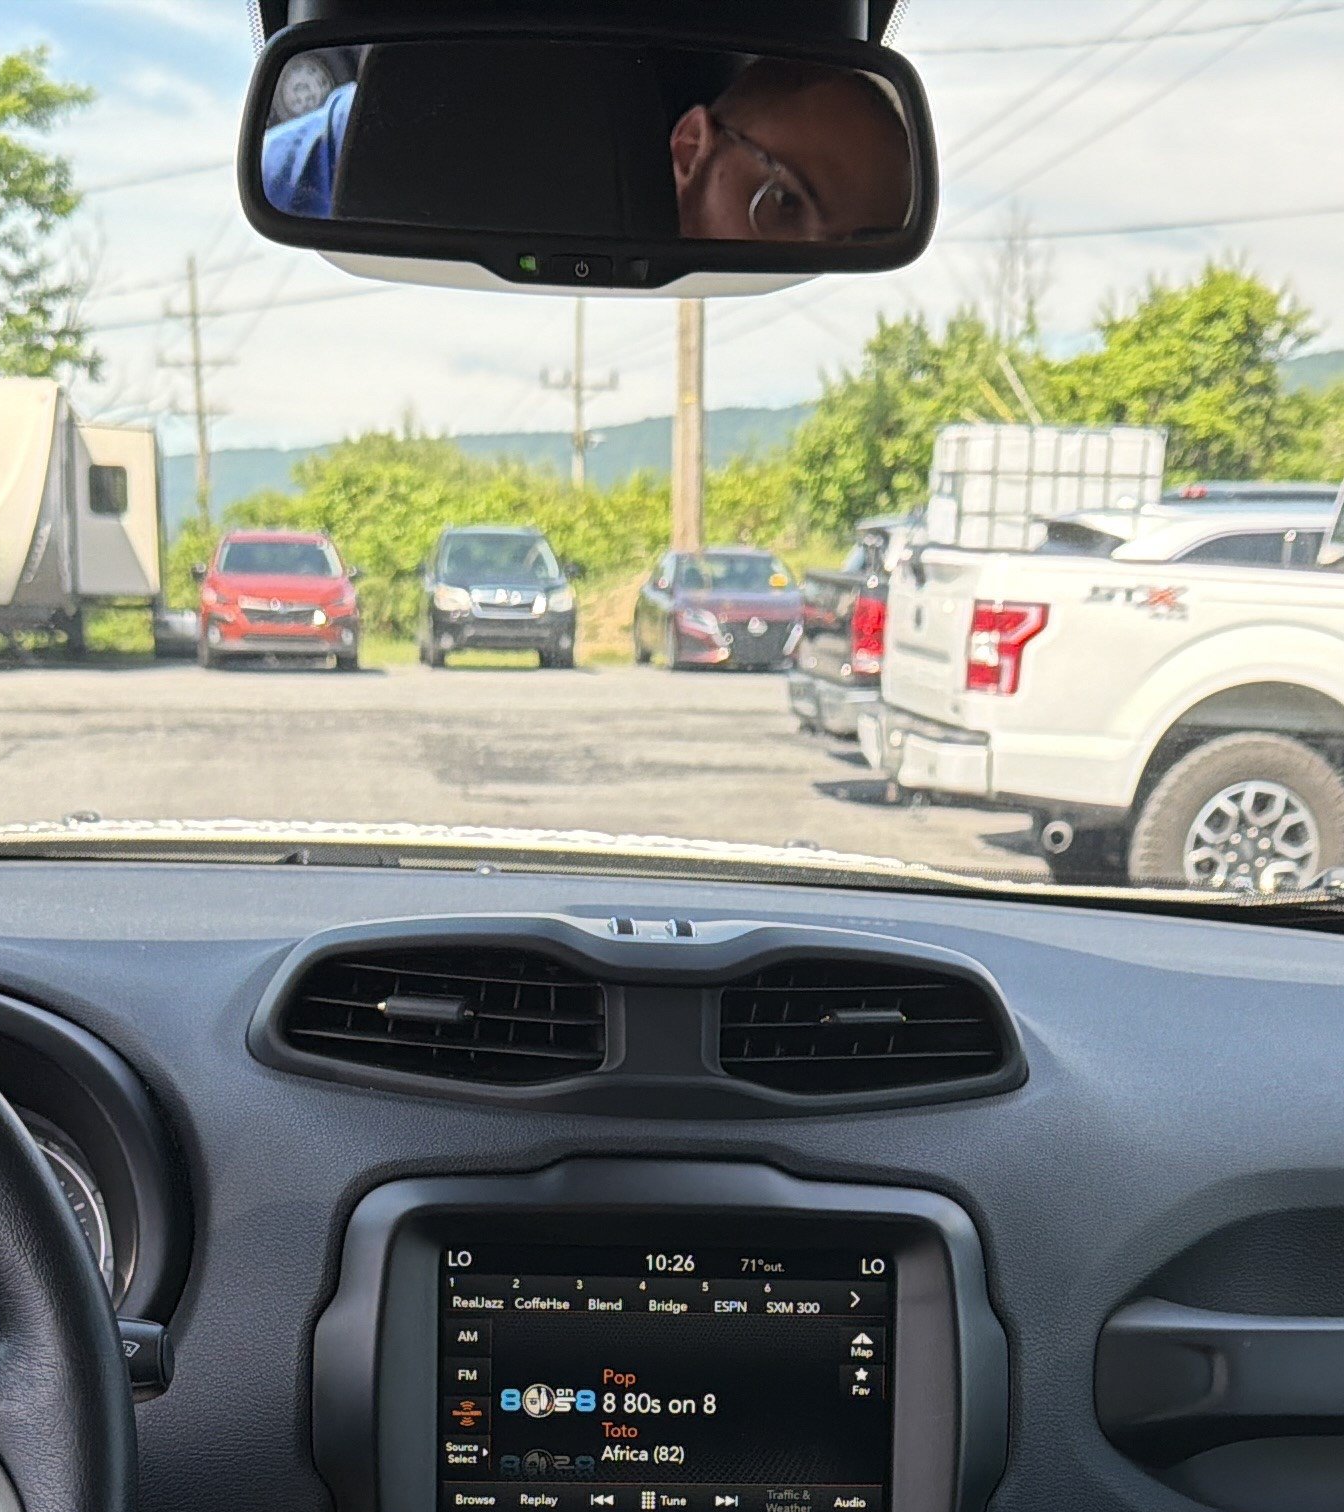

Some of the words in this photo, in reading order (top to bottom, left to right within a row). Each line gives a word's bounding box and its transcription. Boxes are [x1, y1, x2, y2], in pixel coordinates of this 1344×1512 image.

[448, 1250, 473, 1267] LO
[646, 1254, 695, 1271] 10:26
[861, 1258, 885, 1274] LO
[449, 1277, 455, 1287] 1
[512, 1279, 520, 1289] 2
[576, 1280, 583, 1289] 3
[639, 1281, 646, 1290] 4
[702, 1282, 709, 1291] 5
[764, 1283, 771, 1293] 6
[452, 1296, 504, 1309] RealJazz
[514, 1297, 570, 1310] CoffeHse
[588, 1299, 622, 1311] Blend
[648, 1300, 688, 1314] Bridge
[714, 1301, 747, 1313] ESPN
[766, 1302, 793, 1313] SXM
[797, 1302, 820, 1314] 300
[457, 1331, 478, 1342] AM
[851, 1346, 873, 1358] Map
[458, 1370, 477, 1381] FM
[603, 1369, 637, 1387] Pop
[852, 1385, 870, 1396] Fav
[603, 1393, 616, 1414] 8
[623, 1393, 661, 1414] 80s
[669, 1399, 696, 1414] on
[703, 1393, 717, 1414] 8
[602, 1422, 638, 1438] Toto
[446, 1442, 479, 1452] Source
[447, 1454, 477, 1464] Select
[601, 1446, 649, 1462] Africa
[654, 1446, 685, 1464] (82)
[455, 1494, 495, 1505] Browse
[520, 1494, 558, 1508] Replay
[660, 1495, 687, 1506] Tune
[766, 1489, 800, 1501] Traffic
[802, 1490, 811, 1501] &
[834, 1497, 867, 1508] Audio
